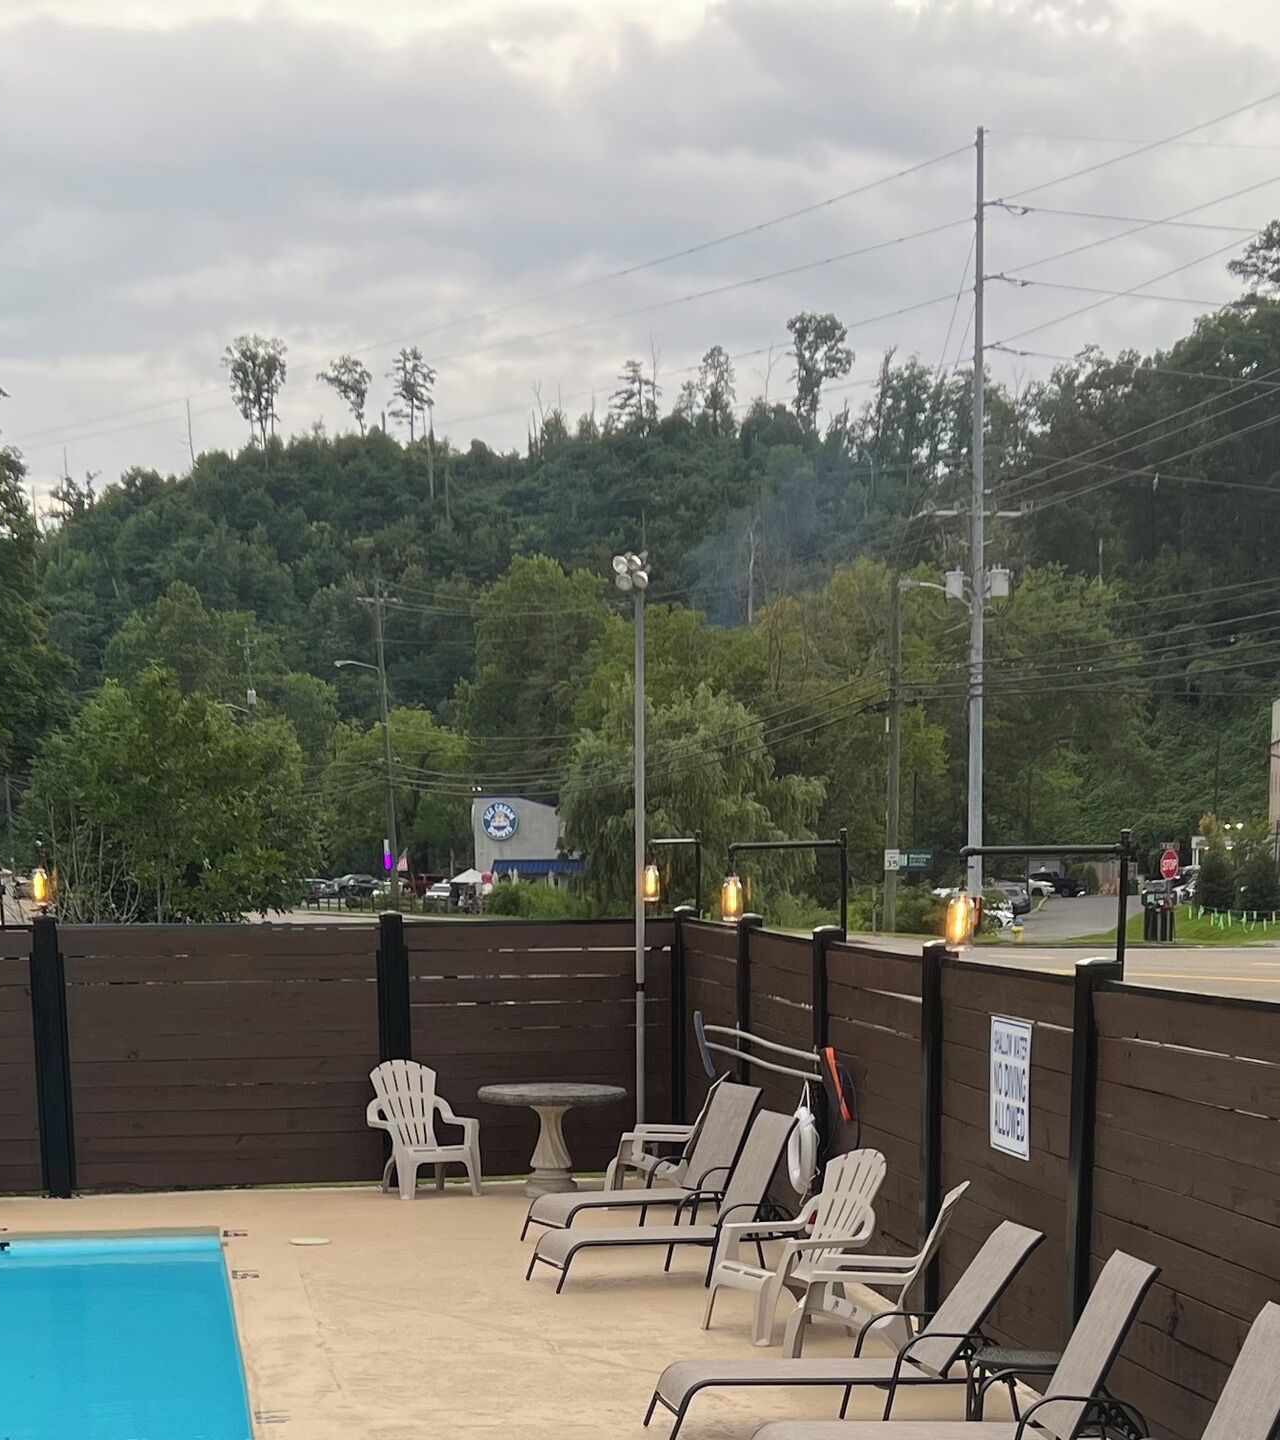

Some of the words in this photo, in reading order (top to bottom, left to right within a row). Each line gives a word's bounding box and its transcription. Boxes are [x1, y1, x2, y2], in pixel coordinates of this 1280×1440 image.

[483, 807, 495, 820] ICE
[494, 803, 515, 820] CREAM
[487, 826, 513, 838] DONUTS
[886, 860, 899, 868] 35
[1162, 859, 1178, 870] STOP
